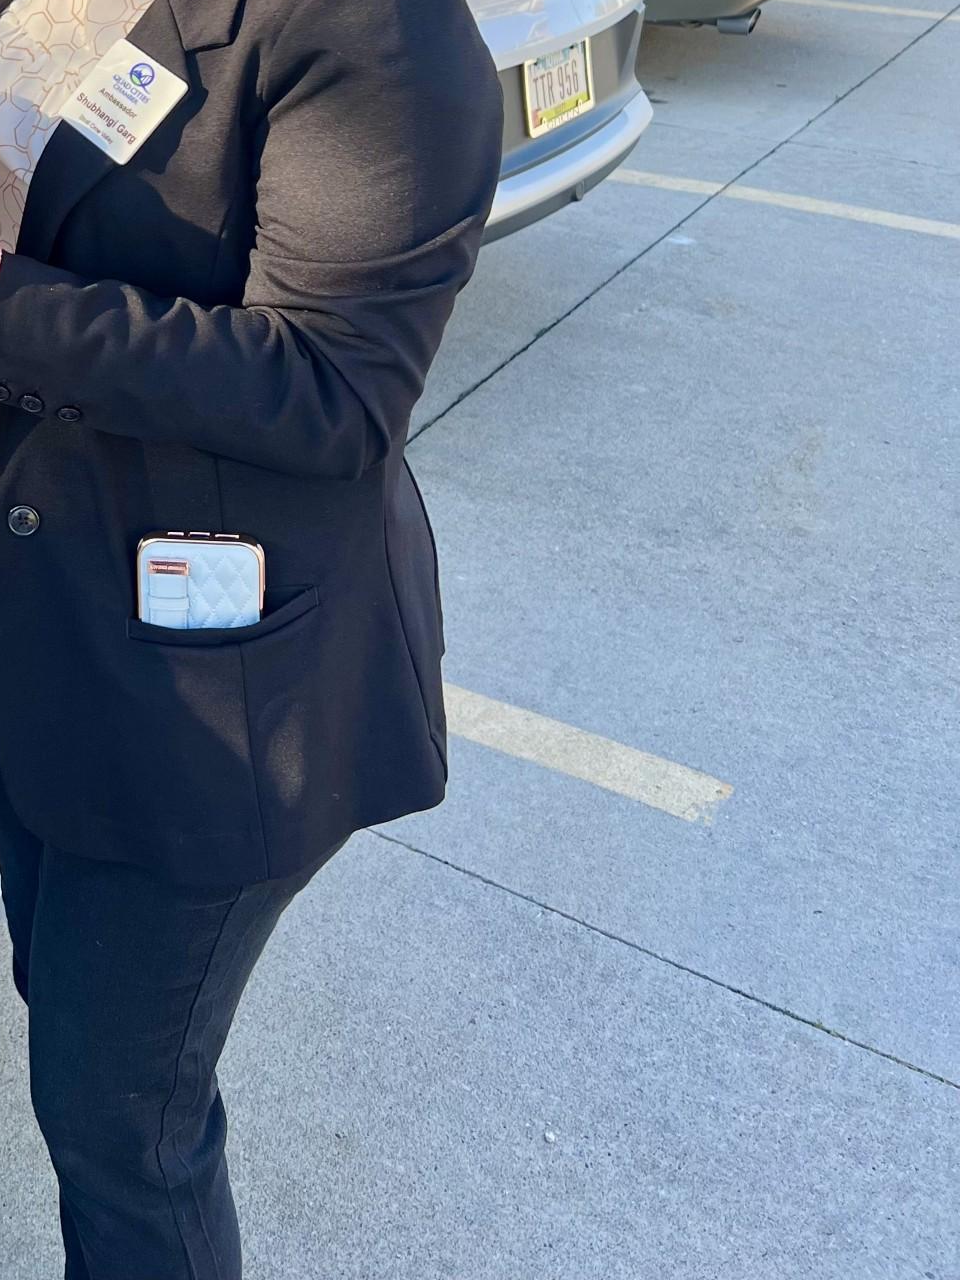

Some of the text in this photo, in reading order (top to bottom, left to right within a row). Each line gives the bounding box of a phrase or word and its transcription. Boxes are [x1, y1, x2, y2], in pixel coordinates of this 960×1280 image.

[557, 58, 580, 100] 956
[76, 92, 137, 145] Shubhangi Garg
[99, 87, 137, 119] Ambassador
